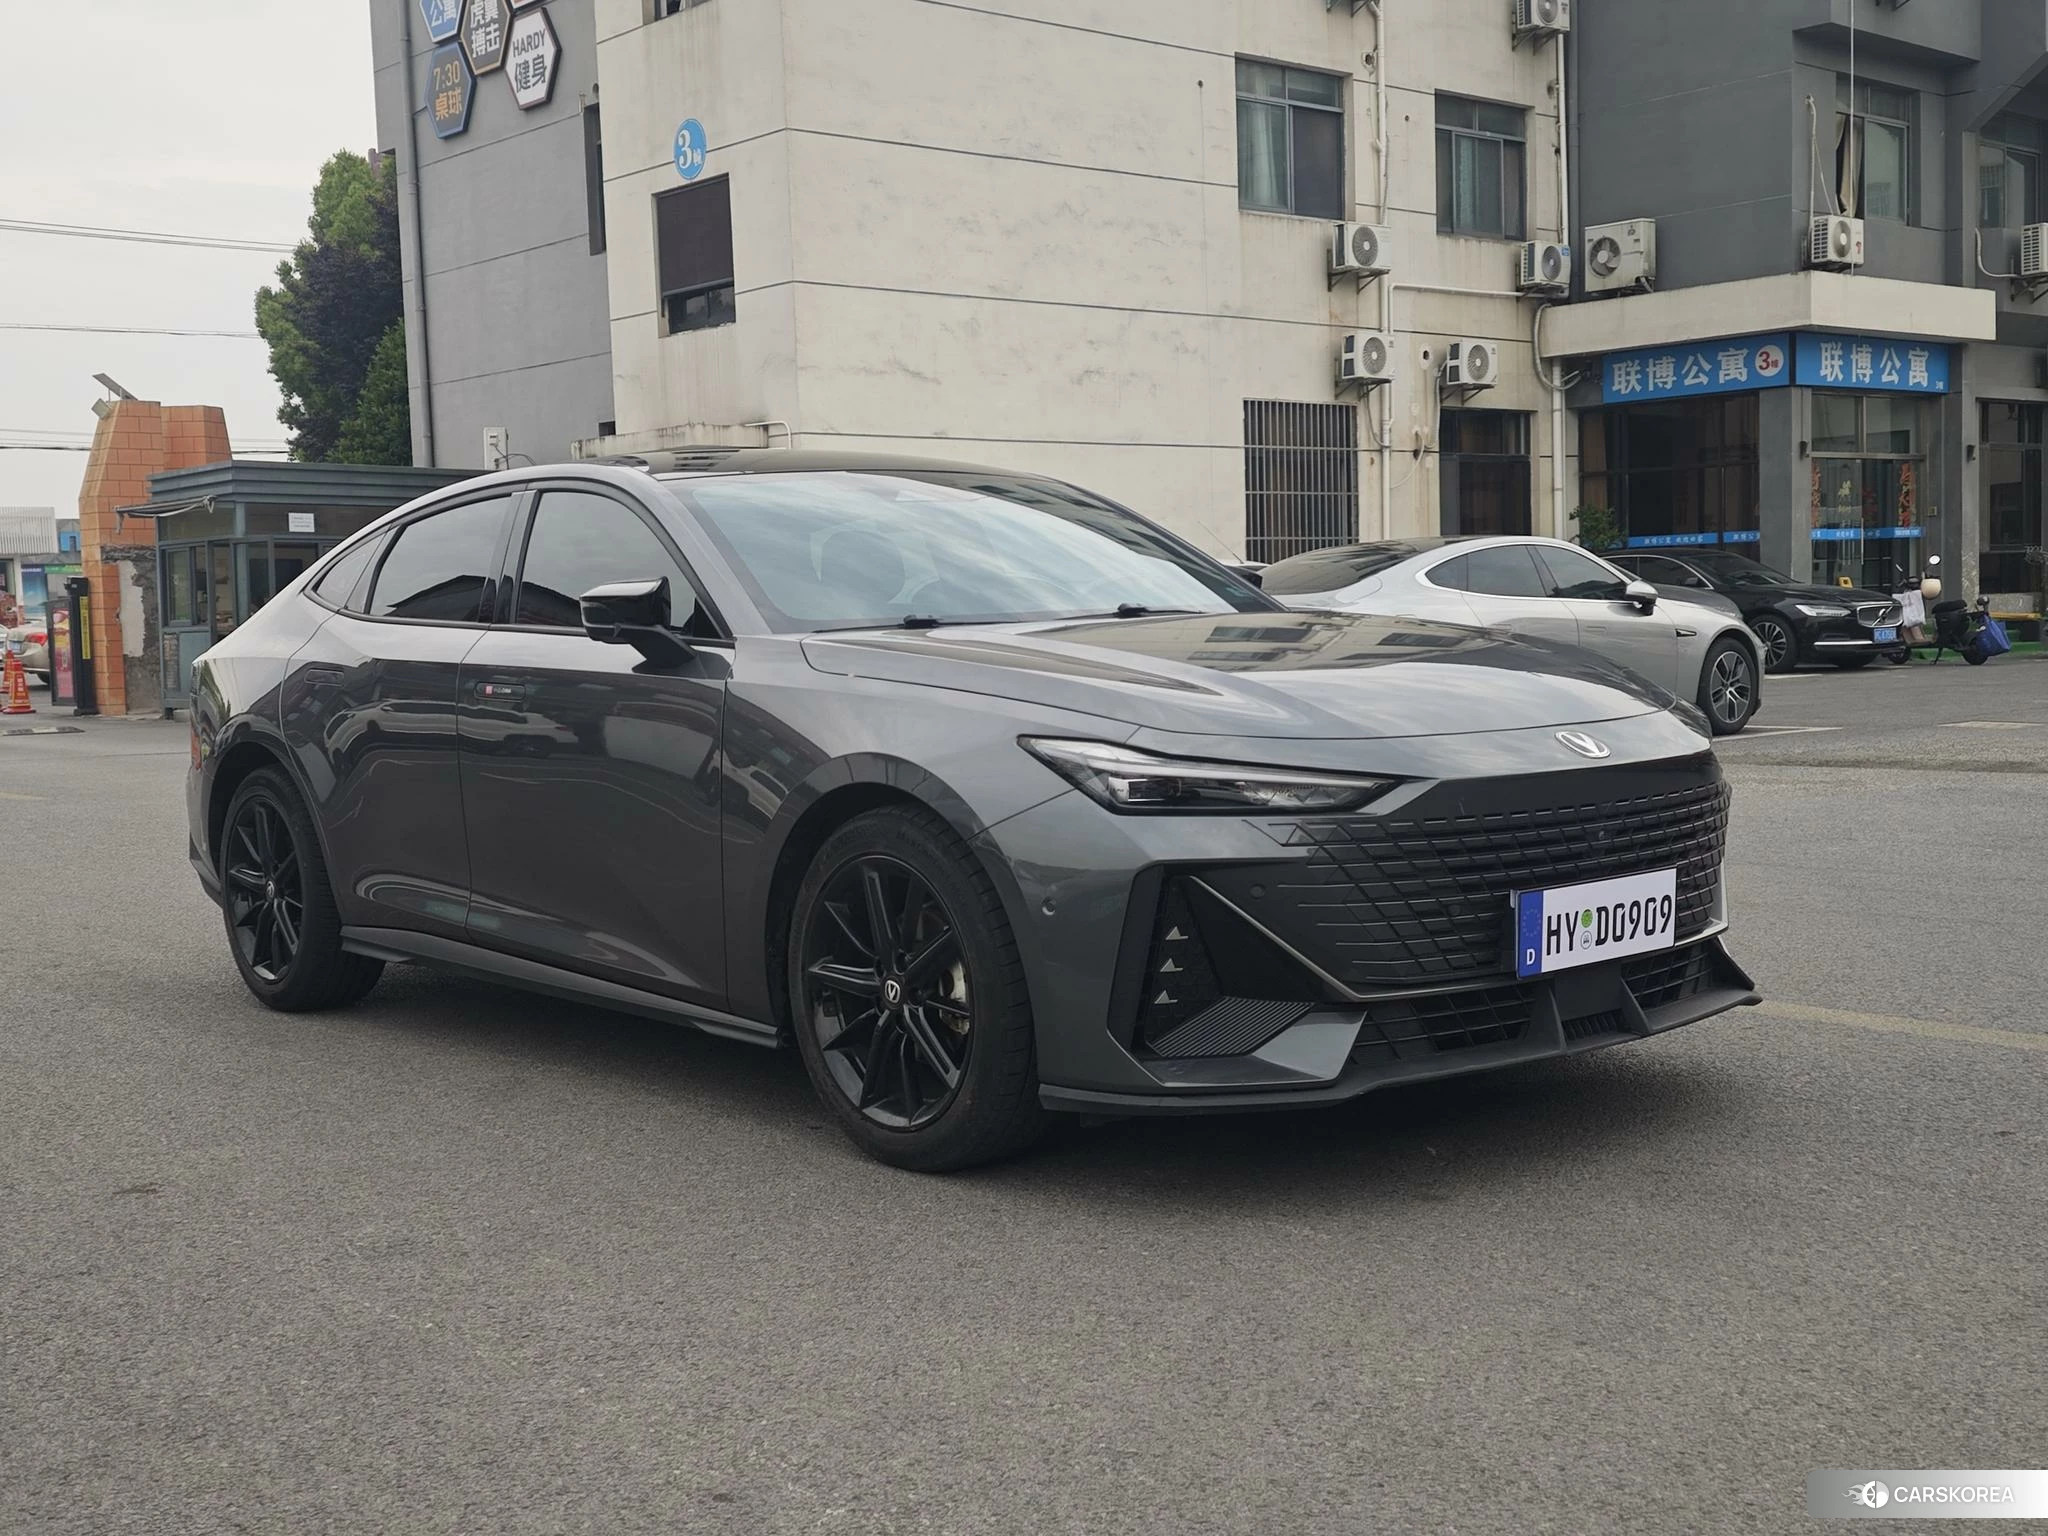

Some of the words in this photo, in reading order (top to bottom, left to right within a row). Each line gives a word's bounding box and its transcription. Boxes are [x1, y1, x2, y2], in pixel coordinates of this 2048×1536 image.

[471, 23, 500, 58] 搏击
[512, 28, 547, 58] HARDY
[433, 60, 460, 90] 7:30
[514, 54, 547, 93] 健身
[435, 87, 462, 121] 桌球
[1611, 348, 1750, 395] 联博公寓
[1819, 341, 1930, 388] 联博公寓
[1546, 911, 1579, 956] HY
[1595, 894, 1672, 947] D0909
[1526, 948, 1536, 965] D
